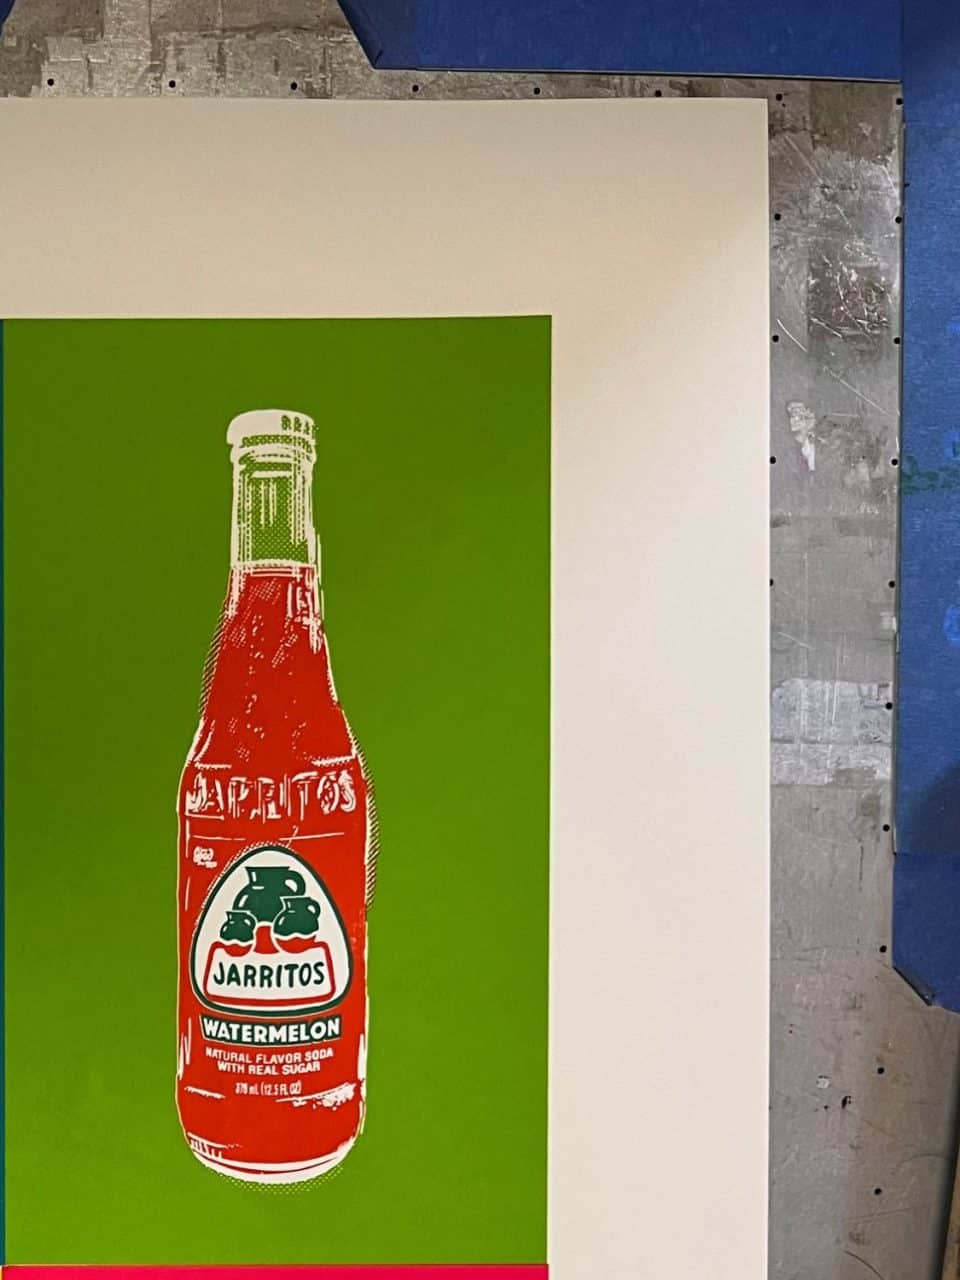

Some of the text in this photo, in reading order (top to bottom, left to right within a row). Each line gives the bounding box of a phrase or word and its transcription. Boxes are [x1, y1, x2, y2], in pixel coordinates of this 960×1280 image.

[213, 962, 325, 988] JARRITOS
[203, 1017, 340, 1044] WATERMELON
[206, 1046, 333, 1064] NATURAL FLAVOR SODA
[217, 1061, 321, 1075] WITH REAL SUGAR
